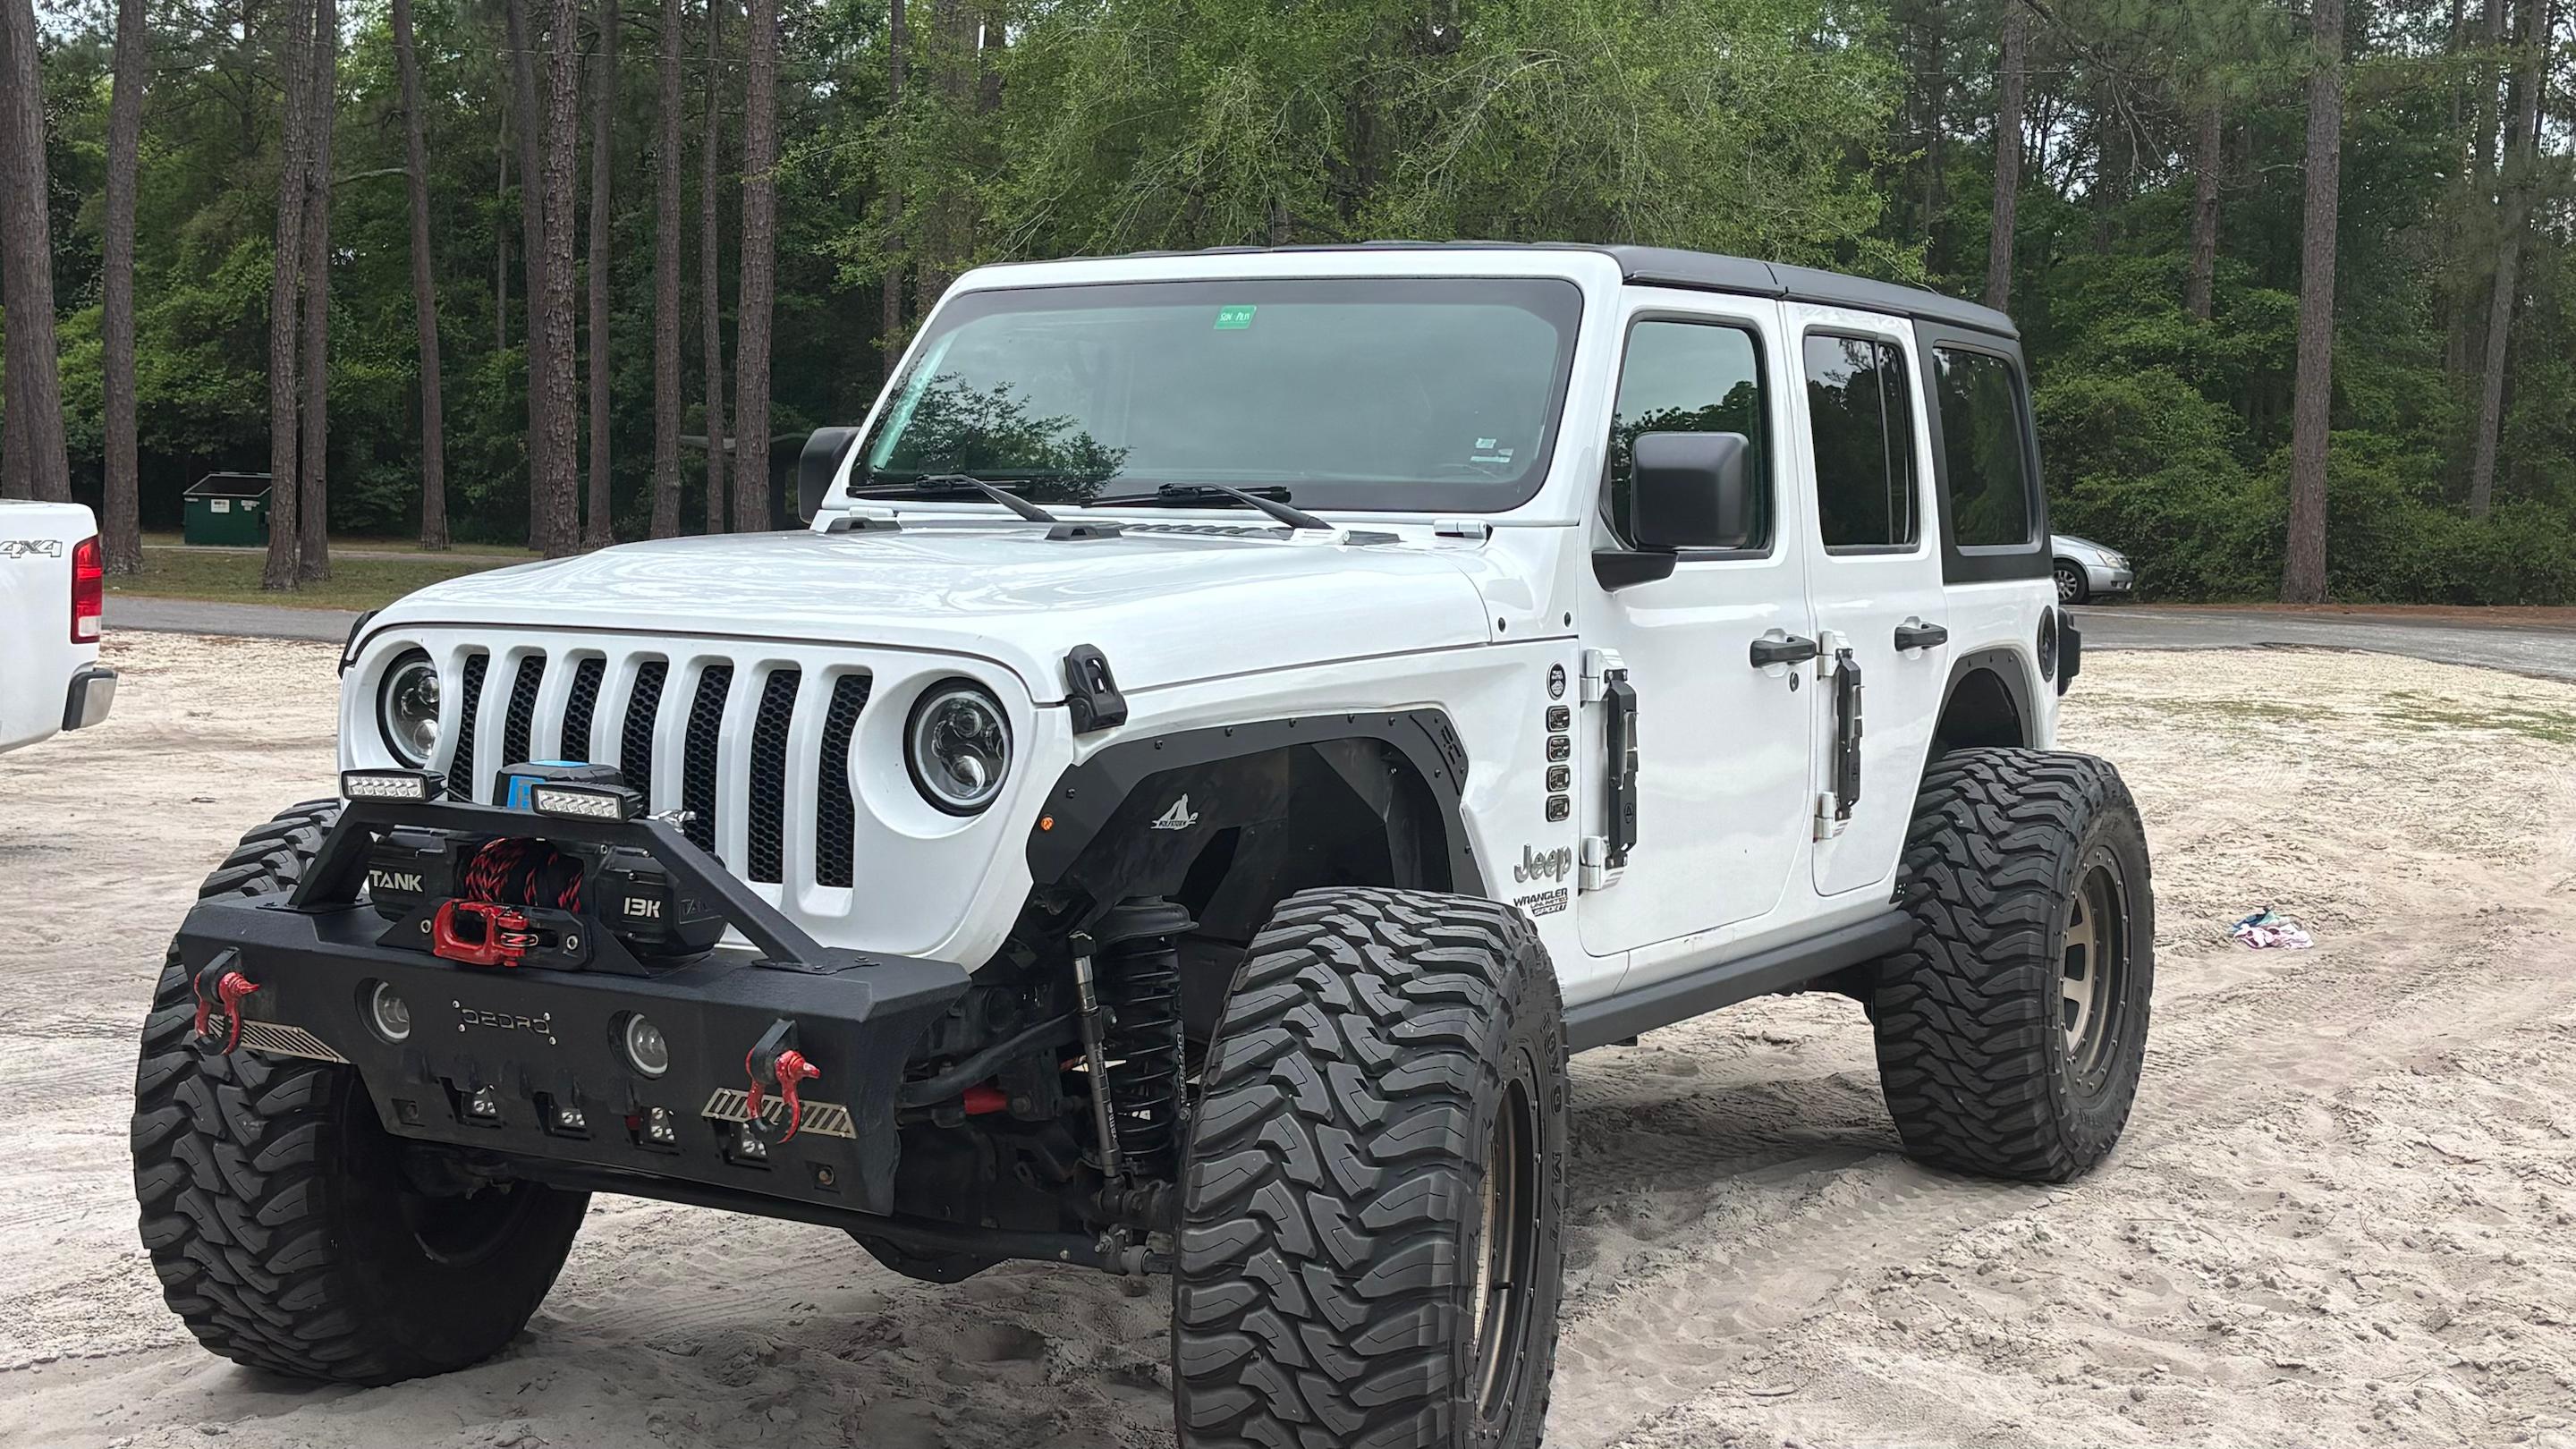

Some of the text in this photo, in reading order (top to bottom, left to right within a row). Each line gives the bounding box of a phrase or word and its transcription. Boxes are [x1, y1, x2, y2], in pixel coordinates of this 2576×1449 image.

[1513, 843, 1572, 884] Jeep
[369, 869, 423, 893] TANK
[1513, 887, 1569, 907] WRANGLER
[623, 897, 661, 919] 13K
[1540, 1012, 1563, 1117] TOYO
[1549, 1151, 1563, 1251] M/T
